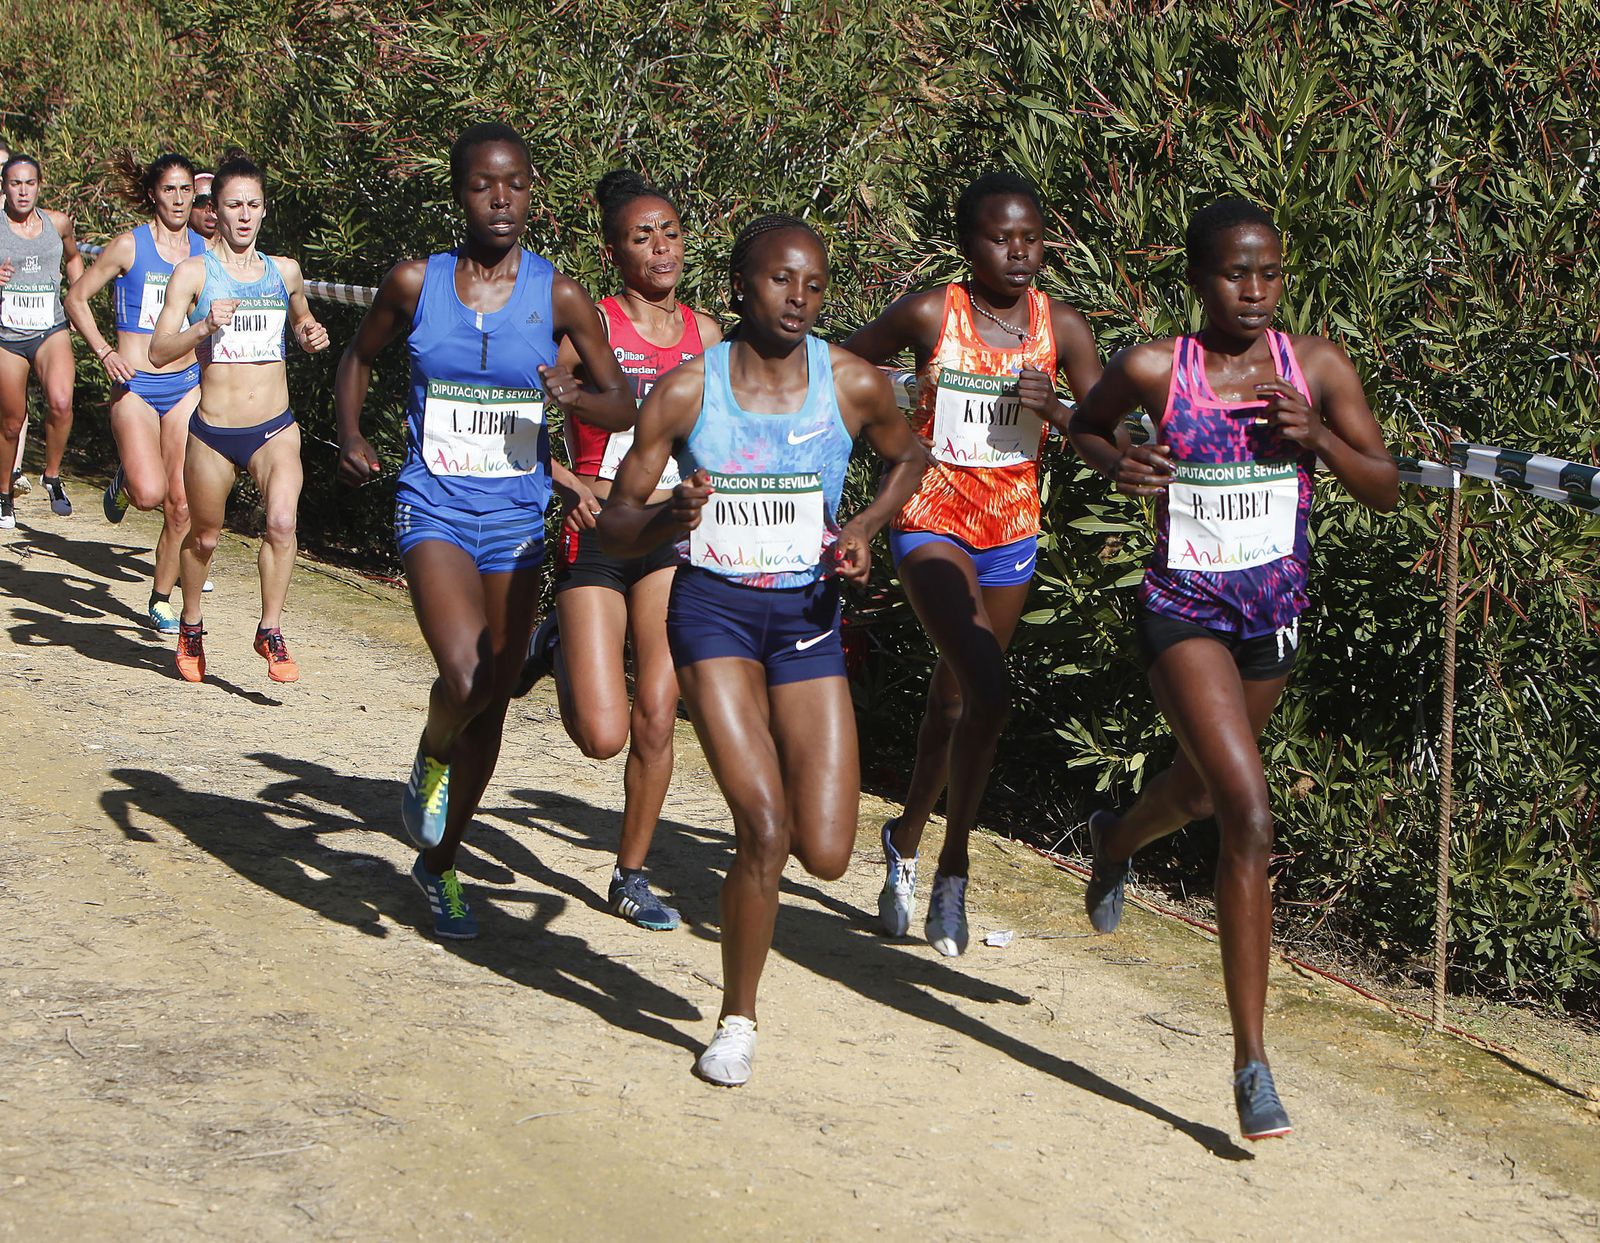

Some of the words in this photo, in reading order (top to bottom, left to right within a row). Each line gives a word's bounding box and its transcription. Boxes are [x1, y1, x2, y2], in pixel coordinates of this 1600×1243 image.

[234, 314, 267, 331] ROCHA
[613, 347, 645, 363] Bilbao
[432, 383, 489, 400] DIPUTACION
[492, 389, 504, 400] DE
[506, 389, 542, 400] SEVILLA
[943, 372, 1000, 392] DIPUTACION
[1003, 381, 1015, 392] DE
[449, 408, 462, 433] A.
[468, 410, 519, 435] JEBET
[963, 399, 1023, 426] KASAIT
[941, 437, 1029, 463] Andalucía
[710, 475, 758, 489] UTACION
[761, 477, 776, 489] DE
[778, 475, 820, 489] SEVILLA
[1173, 465, 1234, 481] DIPUTACION
[1236, 466, 1251, 479] DE
[1253, 462, 1293, 477] SEVILLA
[715, 500, 796, 526] ONSANDO
[1193, 492, 1210, 520] R.
[1216, 489, 1274, 521] JEBET
[702, 543, 811, 568] Andalucía
[1179, 535, 1283, 566] Andalucía
